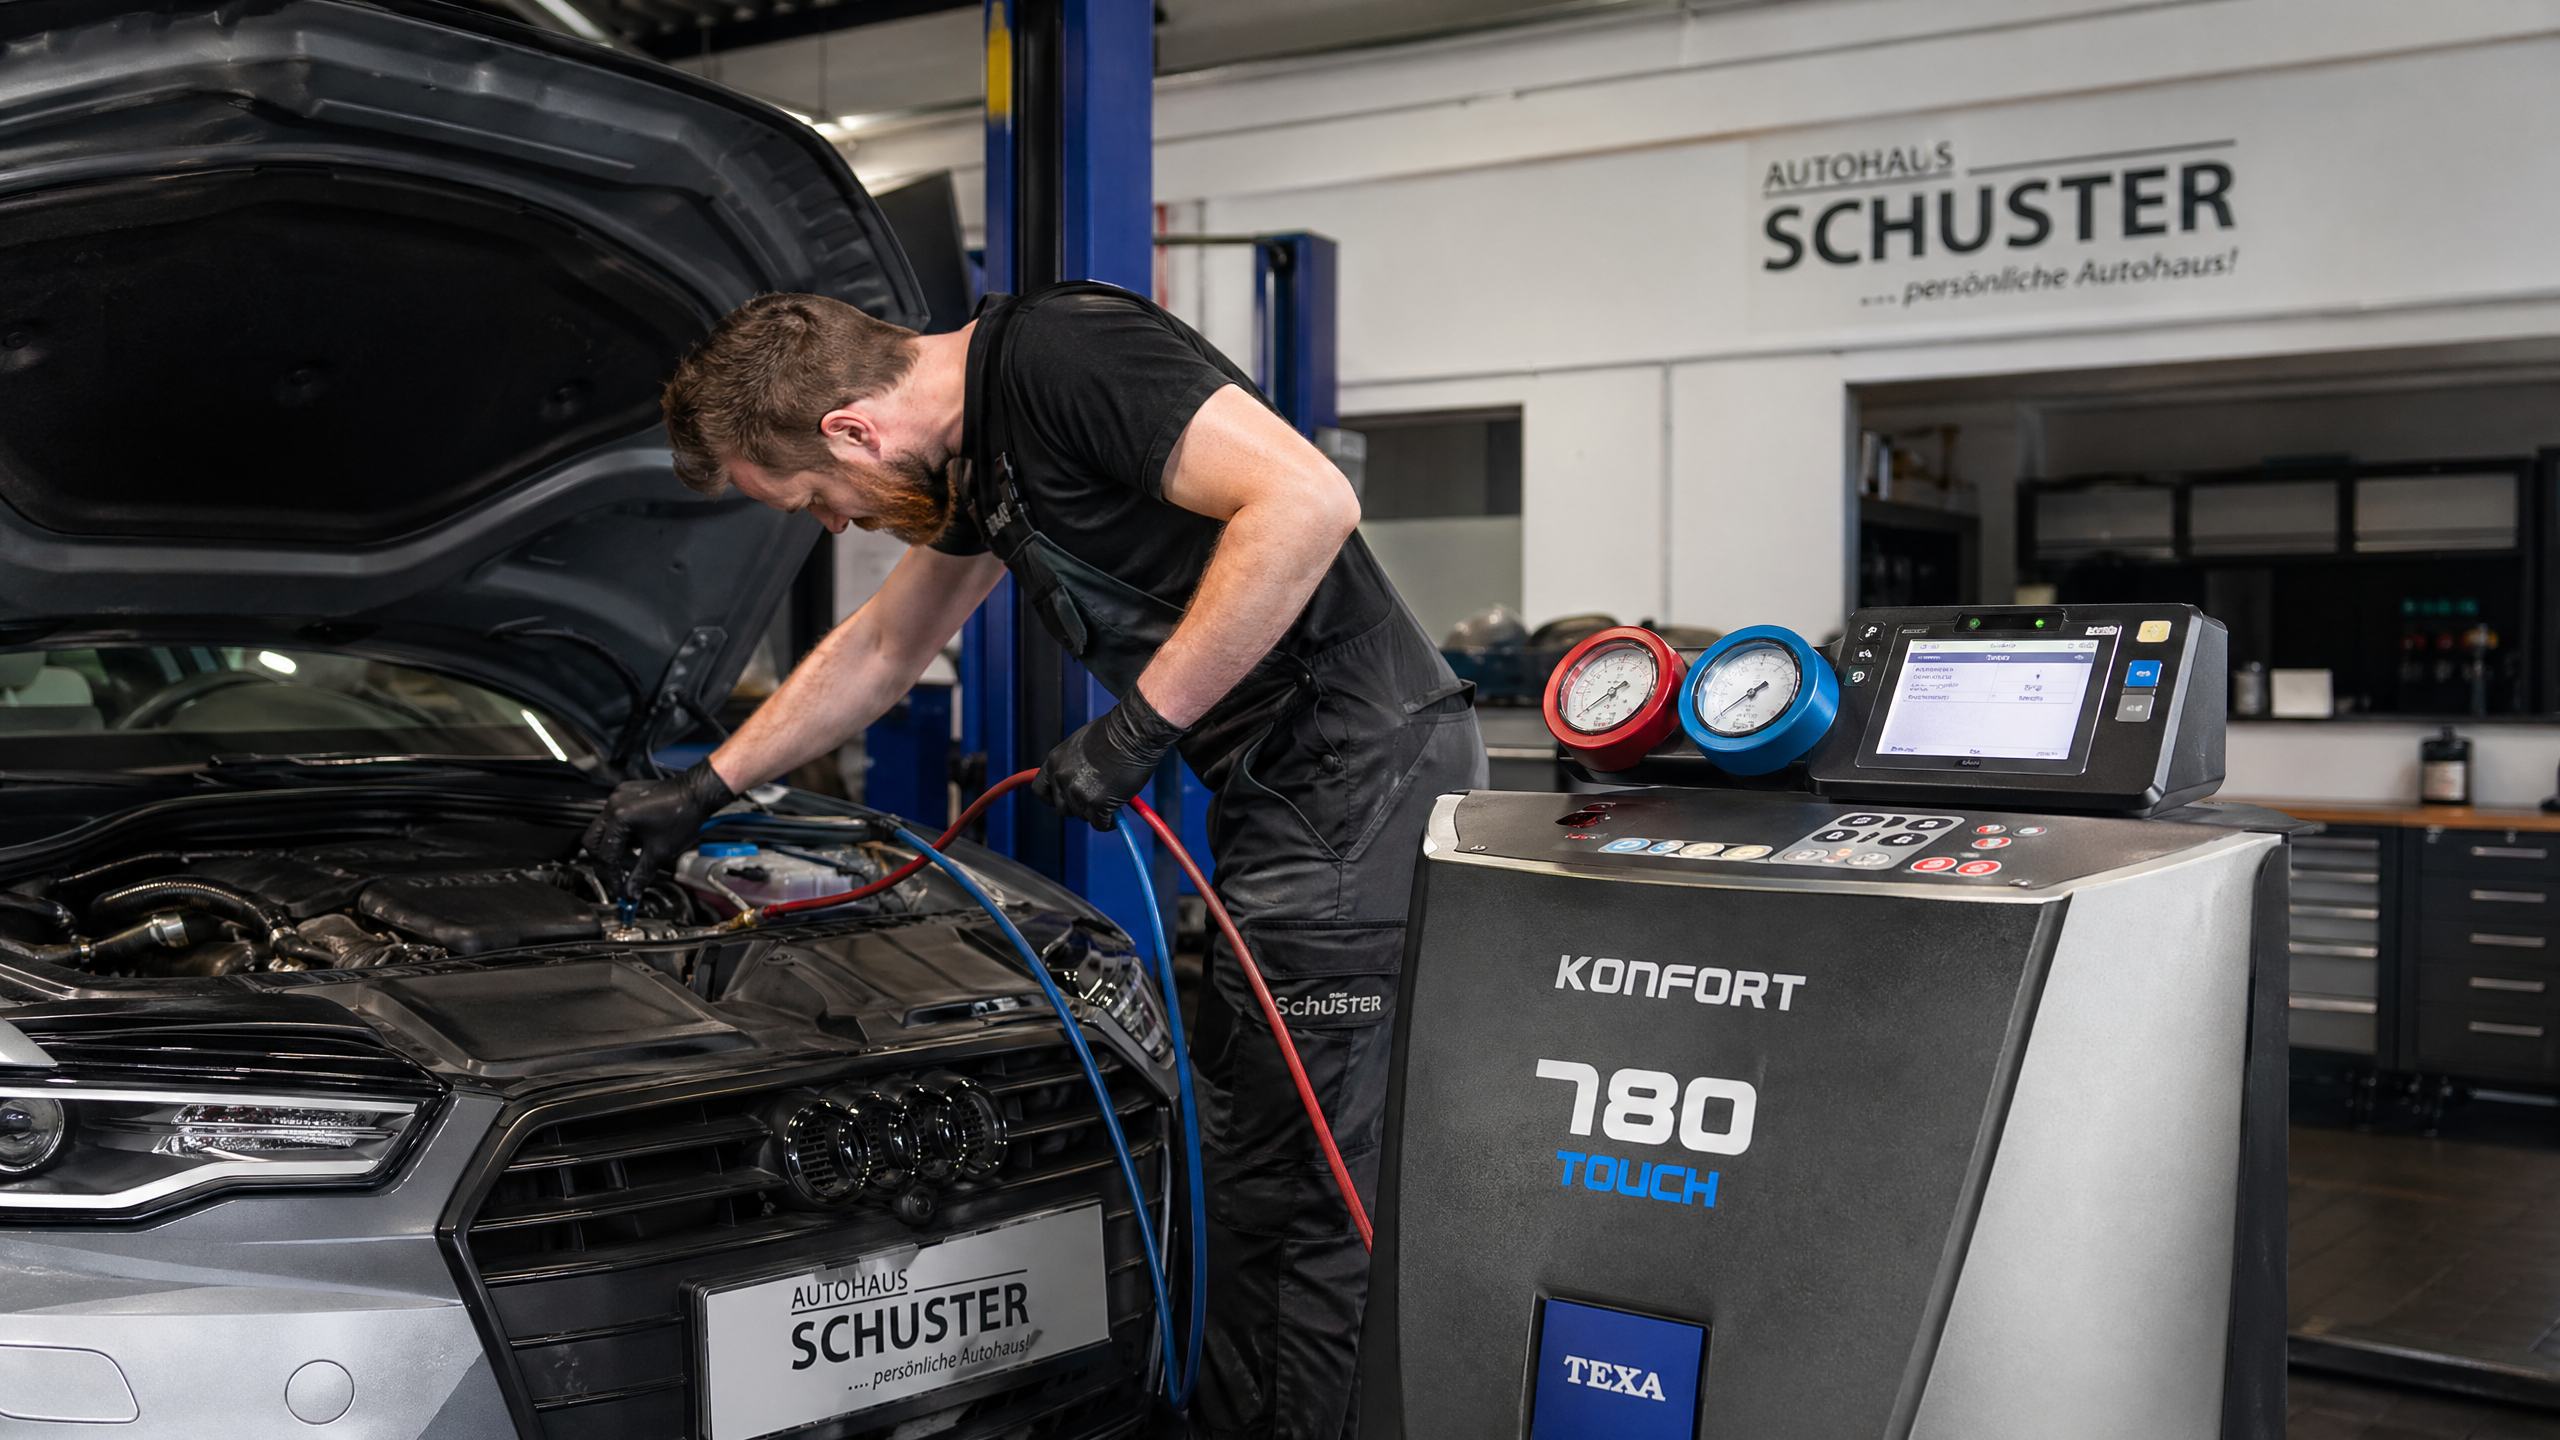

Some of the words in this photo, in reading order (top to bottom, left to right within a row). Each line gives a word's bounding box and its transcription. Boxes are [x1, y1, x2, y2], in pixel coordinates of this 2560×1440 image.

[1764, 141, 1954, 189] AUTOHAUS
[1763, 160, 2236, 272] SCHUSTER
[1903, 262, 2068, 308] persönliche
[2074, 248, 2239, 287] Autohaus!
[1555, 954, 1807, 1011] KONFORT
[1535, 1058, 1757, 1156] 780
[1556, 1150, 1720, 1208] TOUCH
[792, 1268, 908, 1309] AUTOHAUS
[791, 1282, 1031, 1371] SCHUSTER
[872, 1352, 957, 1391] persönliche
[960, 1333, 1031, 1366] Autohaus!
[1563, 1354, 1667, 1402] TEXA
